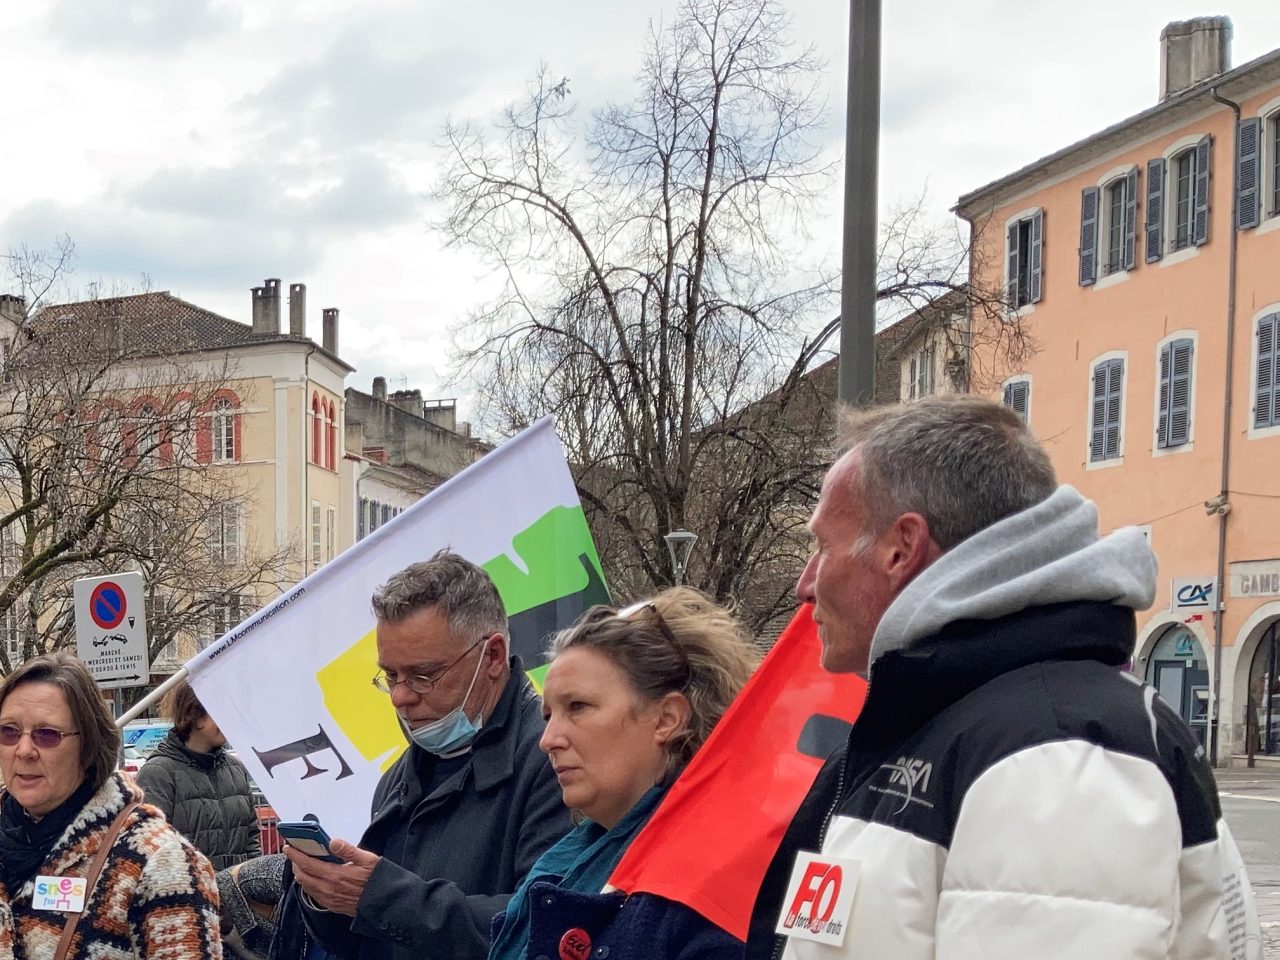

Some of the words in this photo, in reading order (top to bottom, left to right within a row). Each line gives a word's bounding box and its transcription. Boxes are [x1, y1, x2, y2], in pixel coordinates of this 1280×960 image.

[208, 587, 306, 660] www.LMcommunication.com
[37, 878, 84, 896] snes
[783, 861, 843, 934] FO
